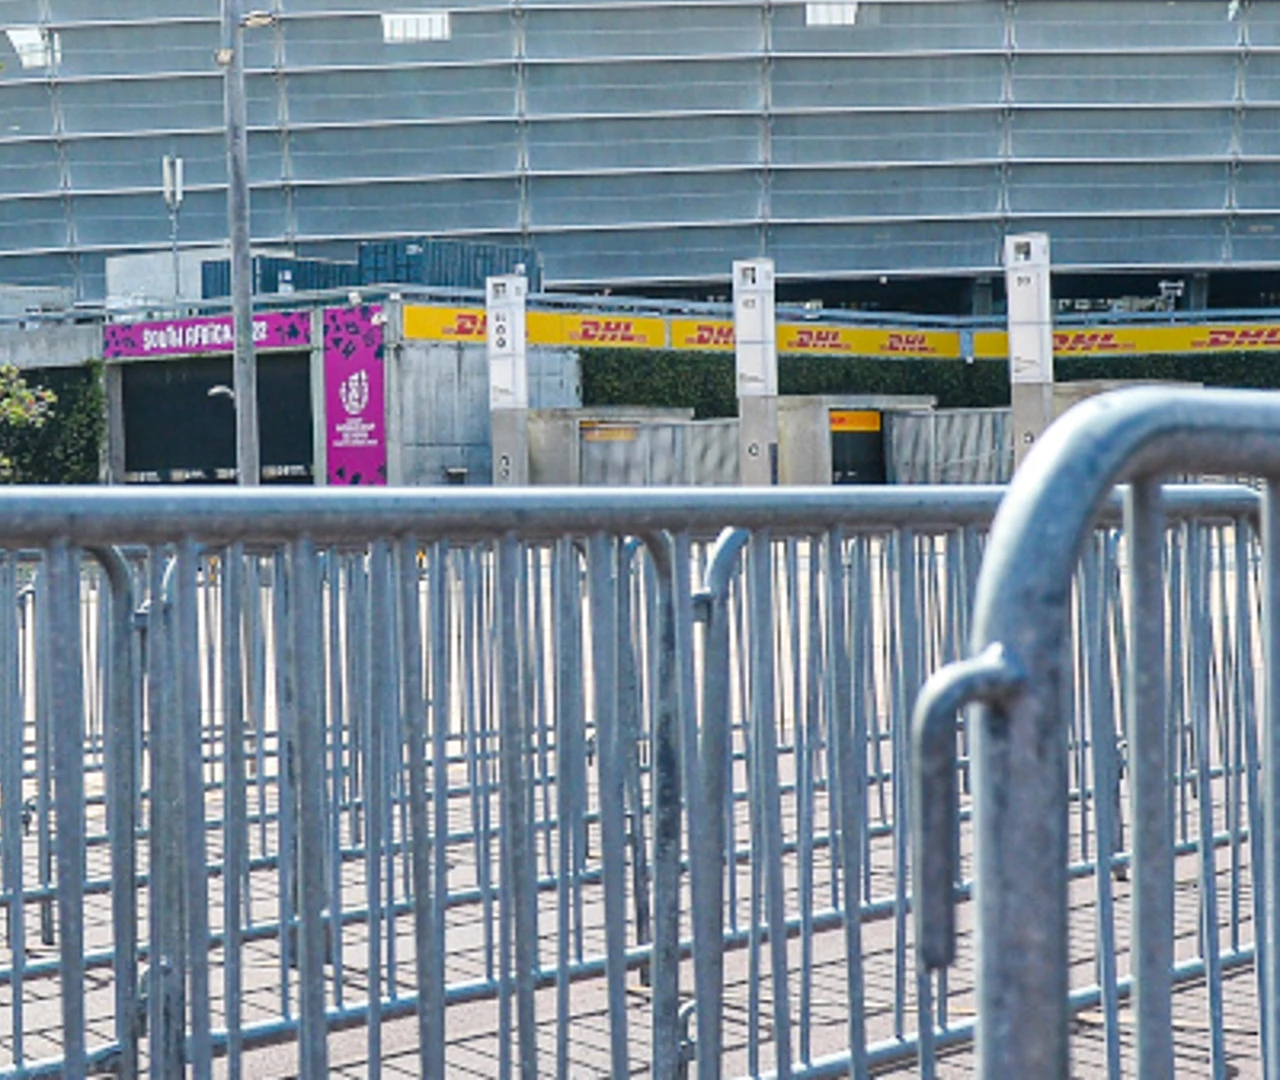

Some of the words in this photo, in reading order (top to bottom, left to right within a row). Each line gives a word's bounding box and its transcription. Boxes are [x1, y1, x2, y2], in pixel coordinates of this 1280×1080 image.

[571, 320, 634, 342] DHL
[796, 330, 842, 348] DHL
[887, 334, 928, 352] DHL
